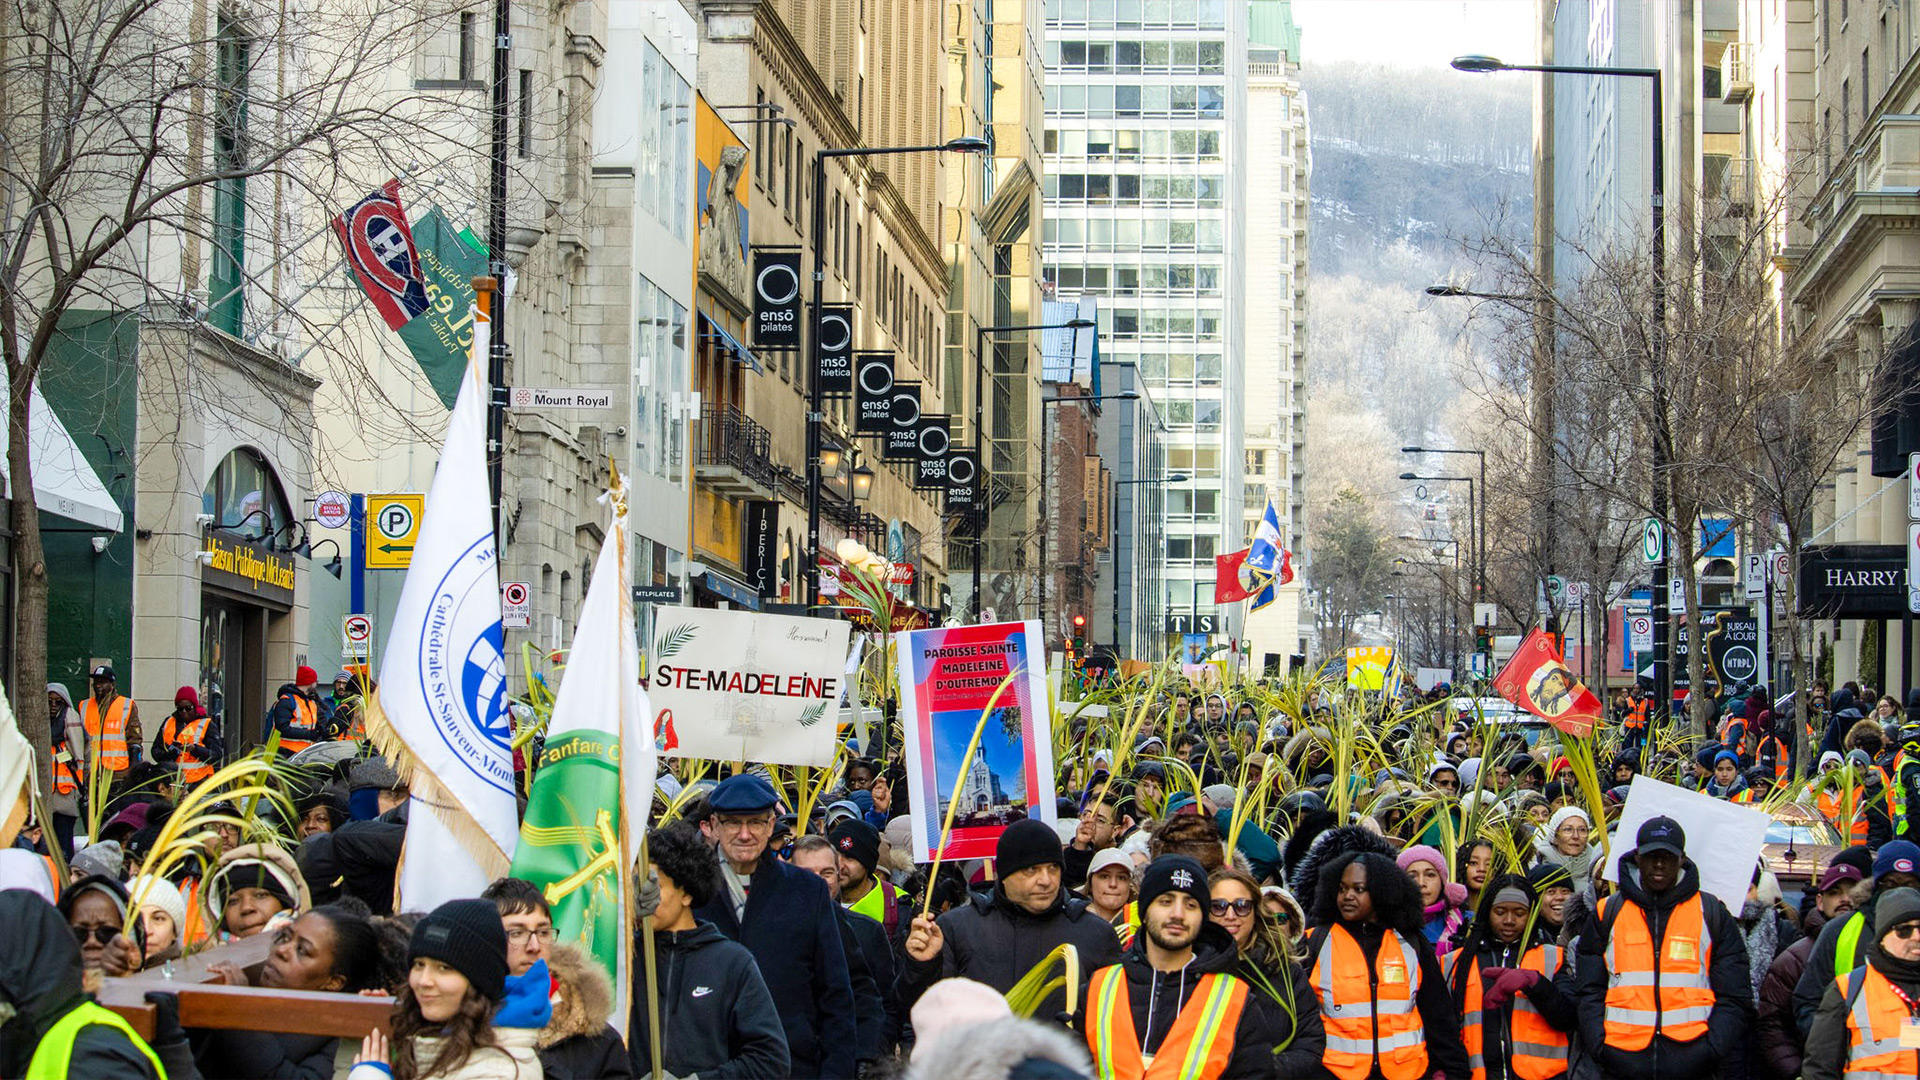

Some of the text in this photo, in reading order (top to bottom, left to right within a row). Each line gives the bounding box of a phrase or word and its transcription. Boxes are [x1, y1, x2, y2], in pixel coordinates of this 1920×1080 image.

[761, 323, 793, 333] pilates
[535, 395, 609, 408] Mount Royal
[862, 411, 889, 419] pilates
[890, 440, 916, 448] pilates
[921, 466, 946, 478] yoga
[389, 511, 405, 532] P
[756, 508, 767, 591] IBERICA
[207, 536, 295, 591] Maison Publique McLean's
[1825, 568, 1899, 586] HARRY
[1727, 622, 1756, 630] BUREAU
[428, 593, 454, 678] Cathédrale
[1733, 632, 1756, 640] LOUER
[924, 642, 1019, 659] PAROISSE SAINTE
[942, 660, 1004, 674] MADELEINE
[936, 675, 1009, 690] D'OUTREMON
[539, 737, 603, 768] Fanfare
